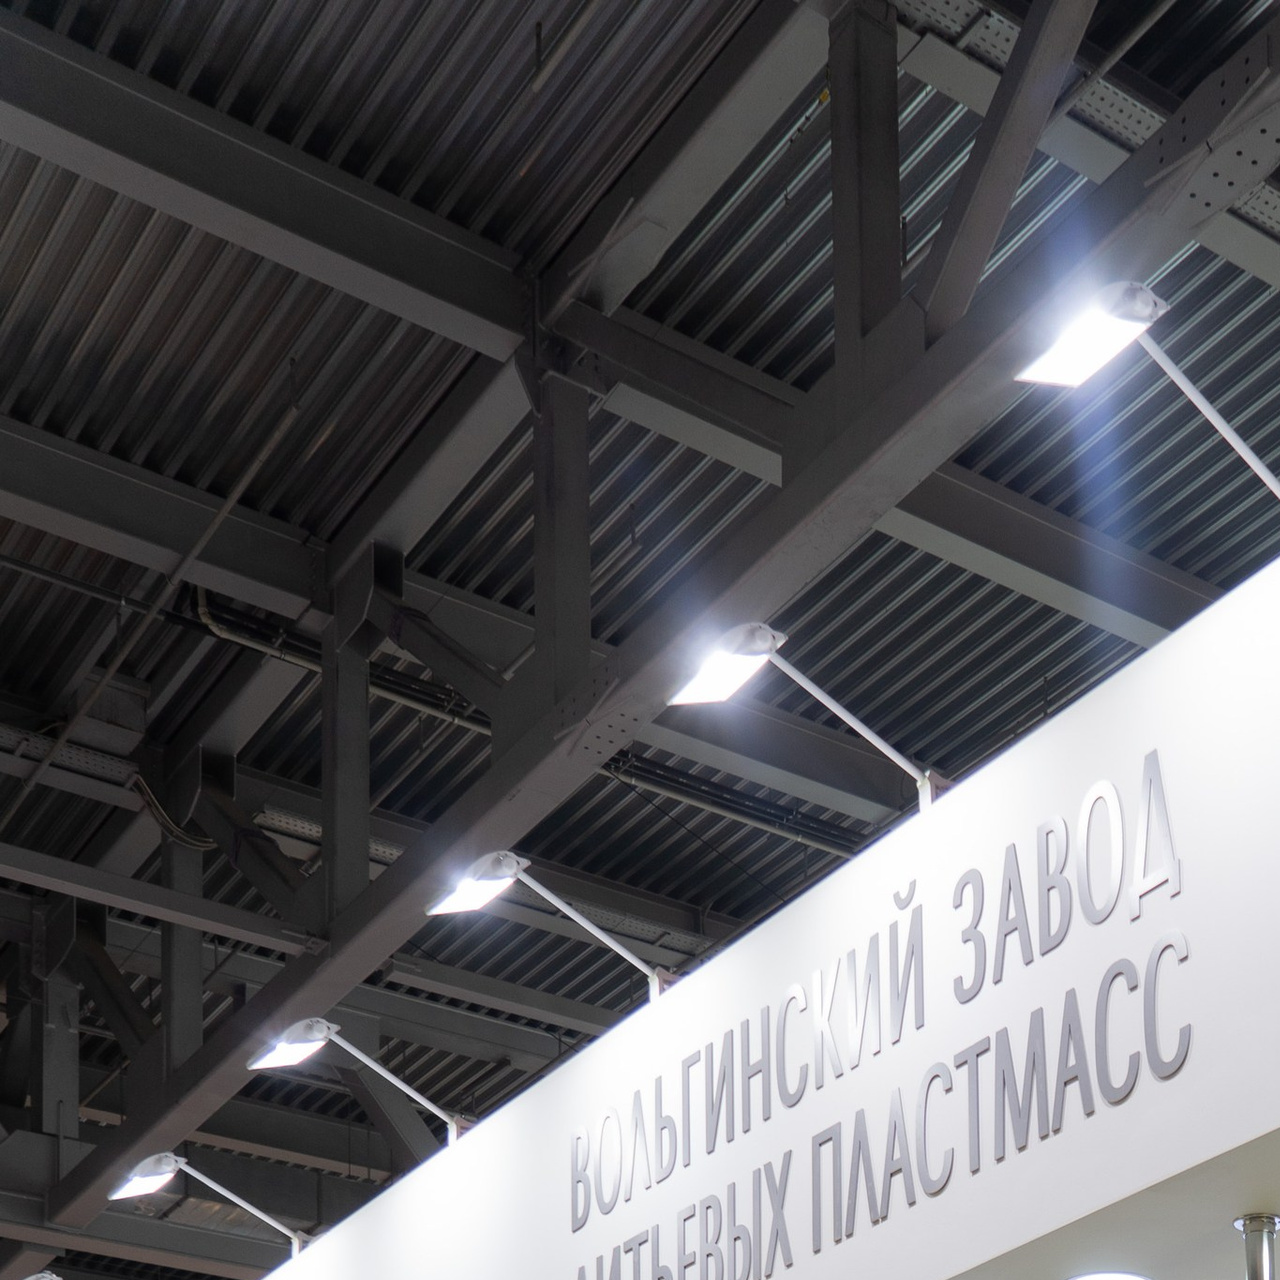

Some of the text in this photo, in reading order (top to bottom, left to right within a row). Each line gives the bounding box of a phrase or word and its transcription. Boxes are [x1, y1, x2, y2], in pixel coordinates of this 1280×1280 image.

[570, 748, 1182, 1234] ВОЛЬГИНСКИЙ ЗАВОД
[811, 929, 1192, 1254] ПЛАСТМАСС
